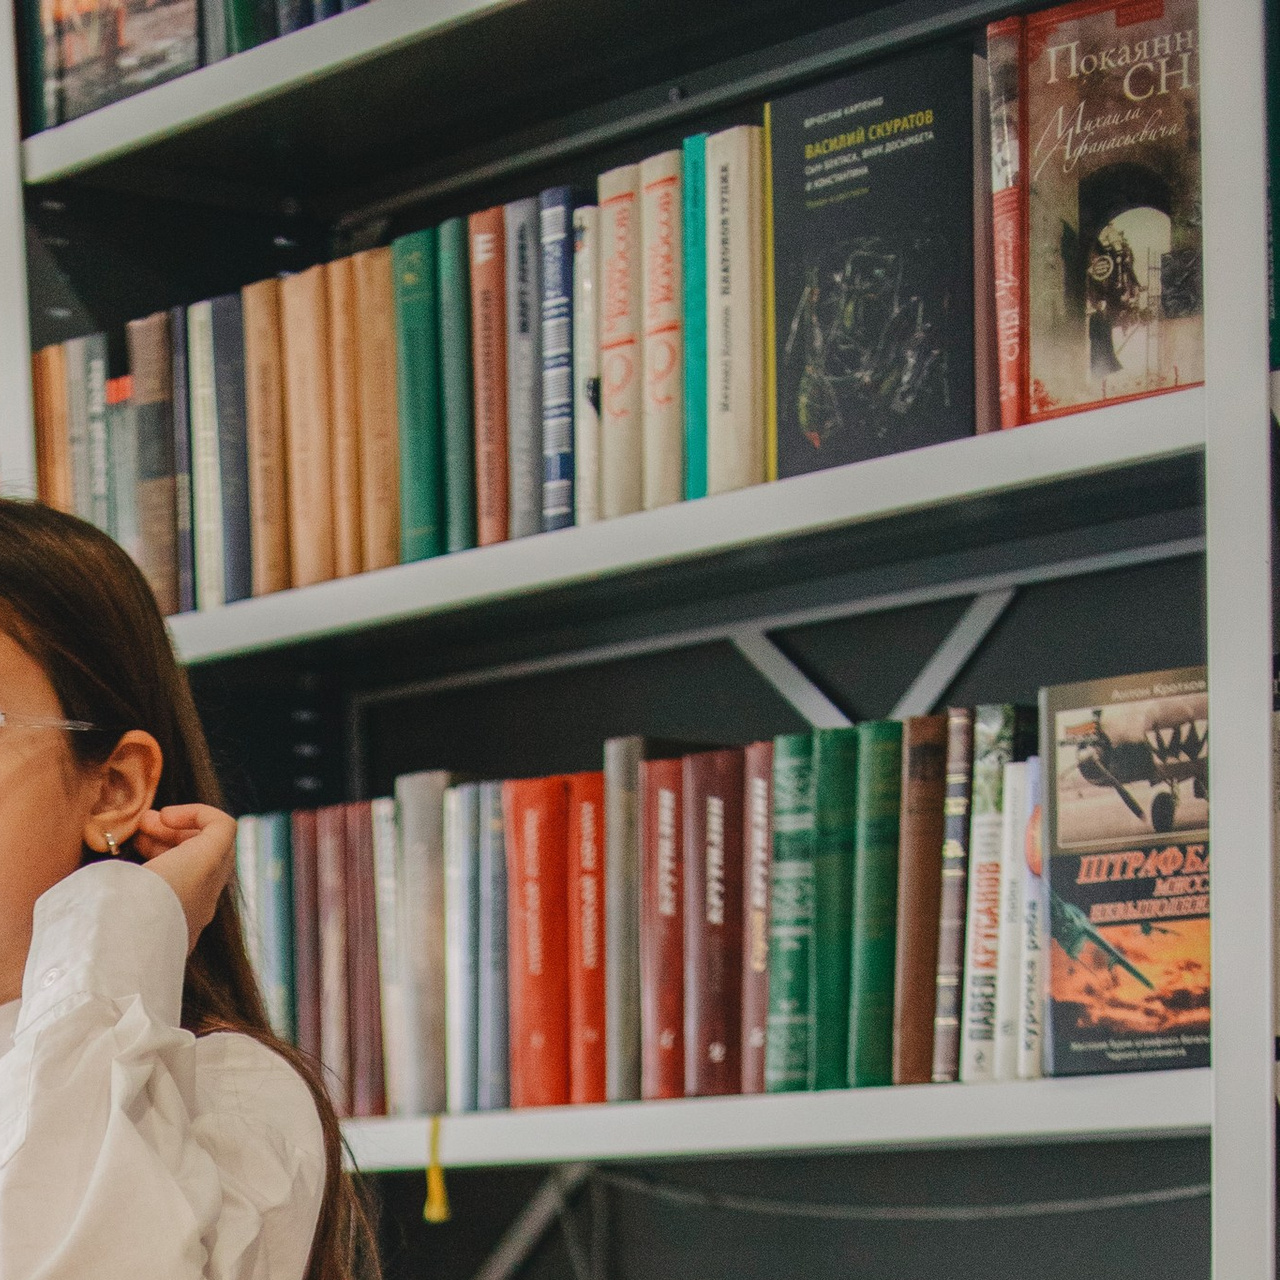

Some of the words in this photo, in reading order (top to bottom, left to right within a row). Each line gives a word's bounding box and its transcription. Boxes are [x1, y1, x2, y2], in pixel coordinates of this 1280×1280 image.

[1046, 30, 1200, 84] Покаянн
[1123, 52, 1200, 101] СН
[804, 125, 865, 160] ВАСИЛИЙ
[868, 109, 934, 142] СКУРАТОВ
[1033, 109, 1183, 181] Афанасьевича
[1034, 100, 1143, 157] Михаила
[973, 861, 1000, 970] КРУСАНОВ
[969, 974, 995, 1041] ПАВЕЛ
